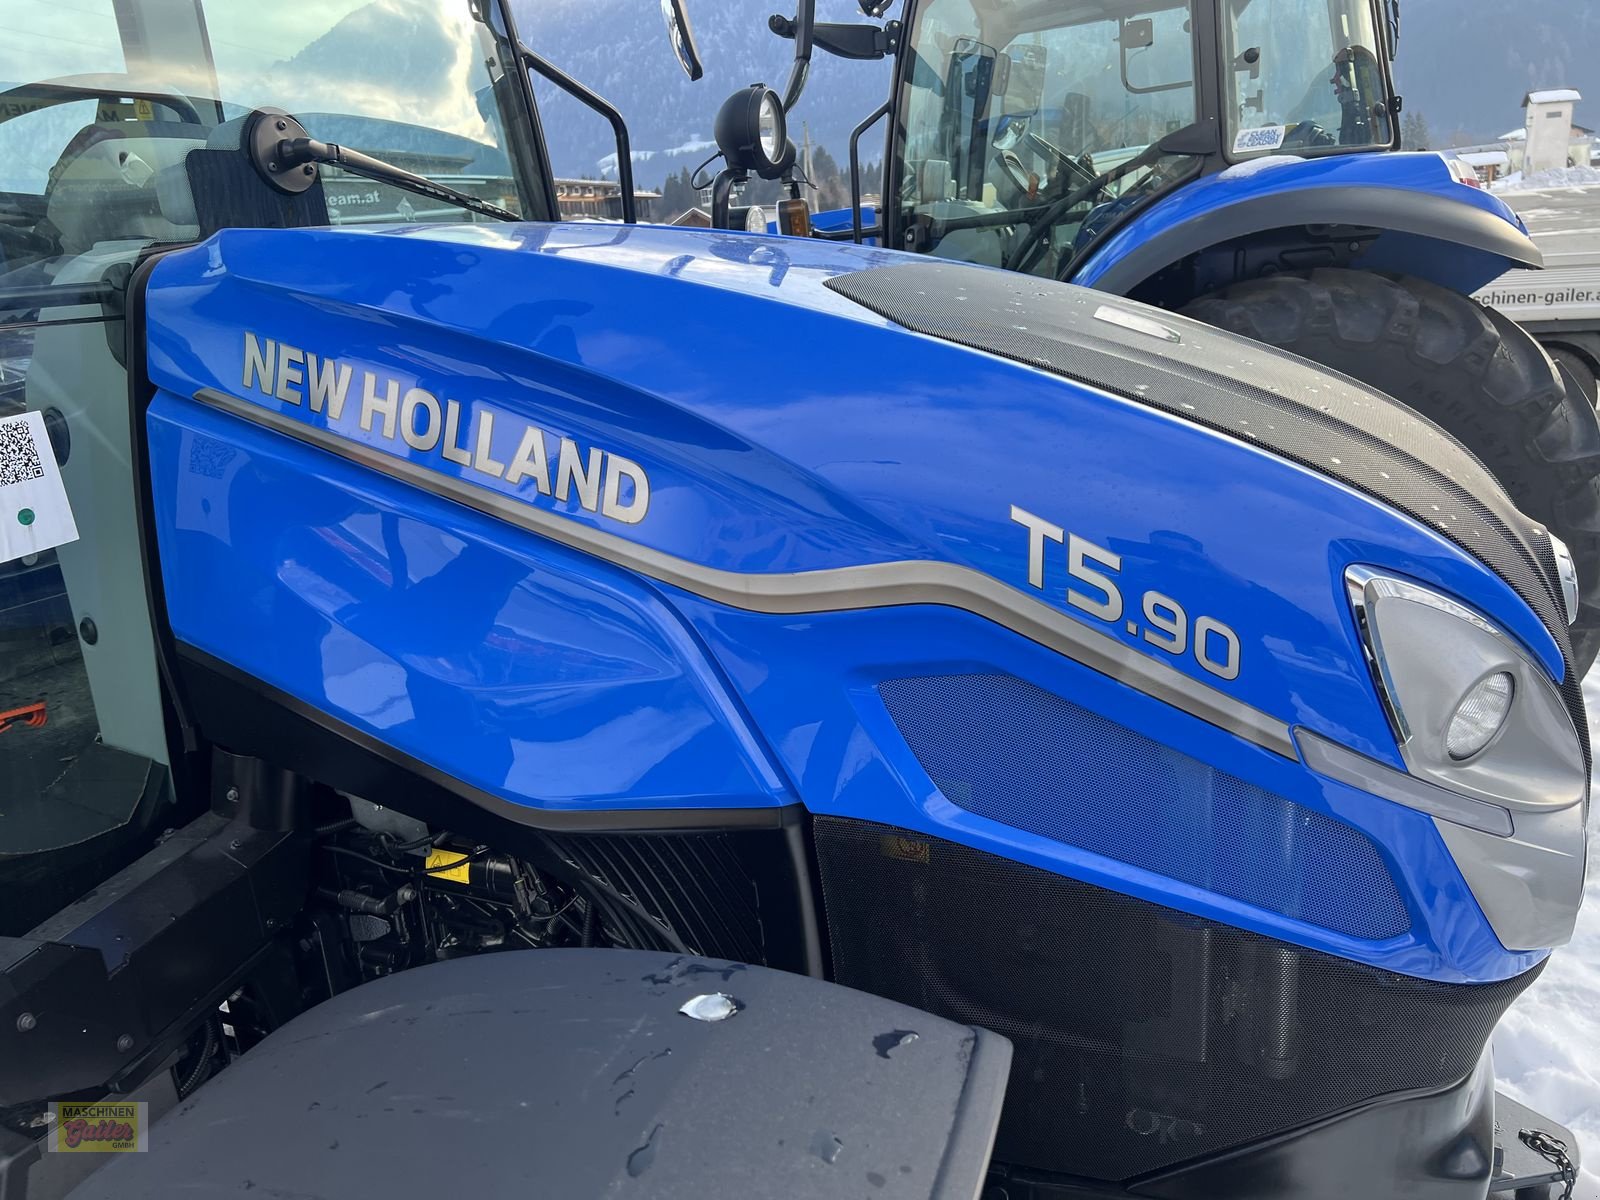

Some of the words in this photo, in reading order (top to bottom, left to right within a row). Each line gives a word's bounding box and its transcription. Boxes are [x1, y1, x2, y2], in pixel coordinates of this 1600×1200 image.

[1250, 129, 1277, 137] CLEAN
[325, 190, 381, 206] eam.at
[242, 331, 353, 420] NEW
[359, 371, 650, 525] HOLLAND
[1010, 503, 1241, 681] T5.90
